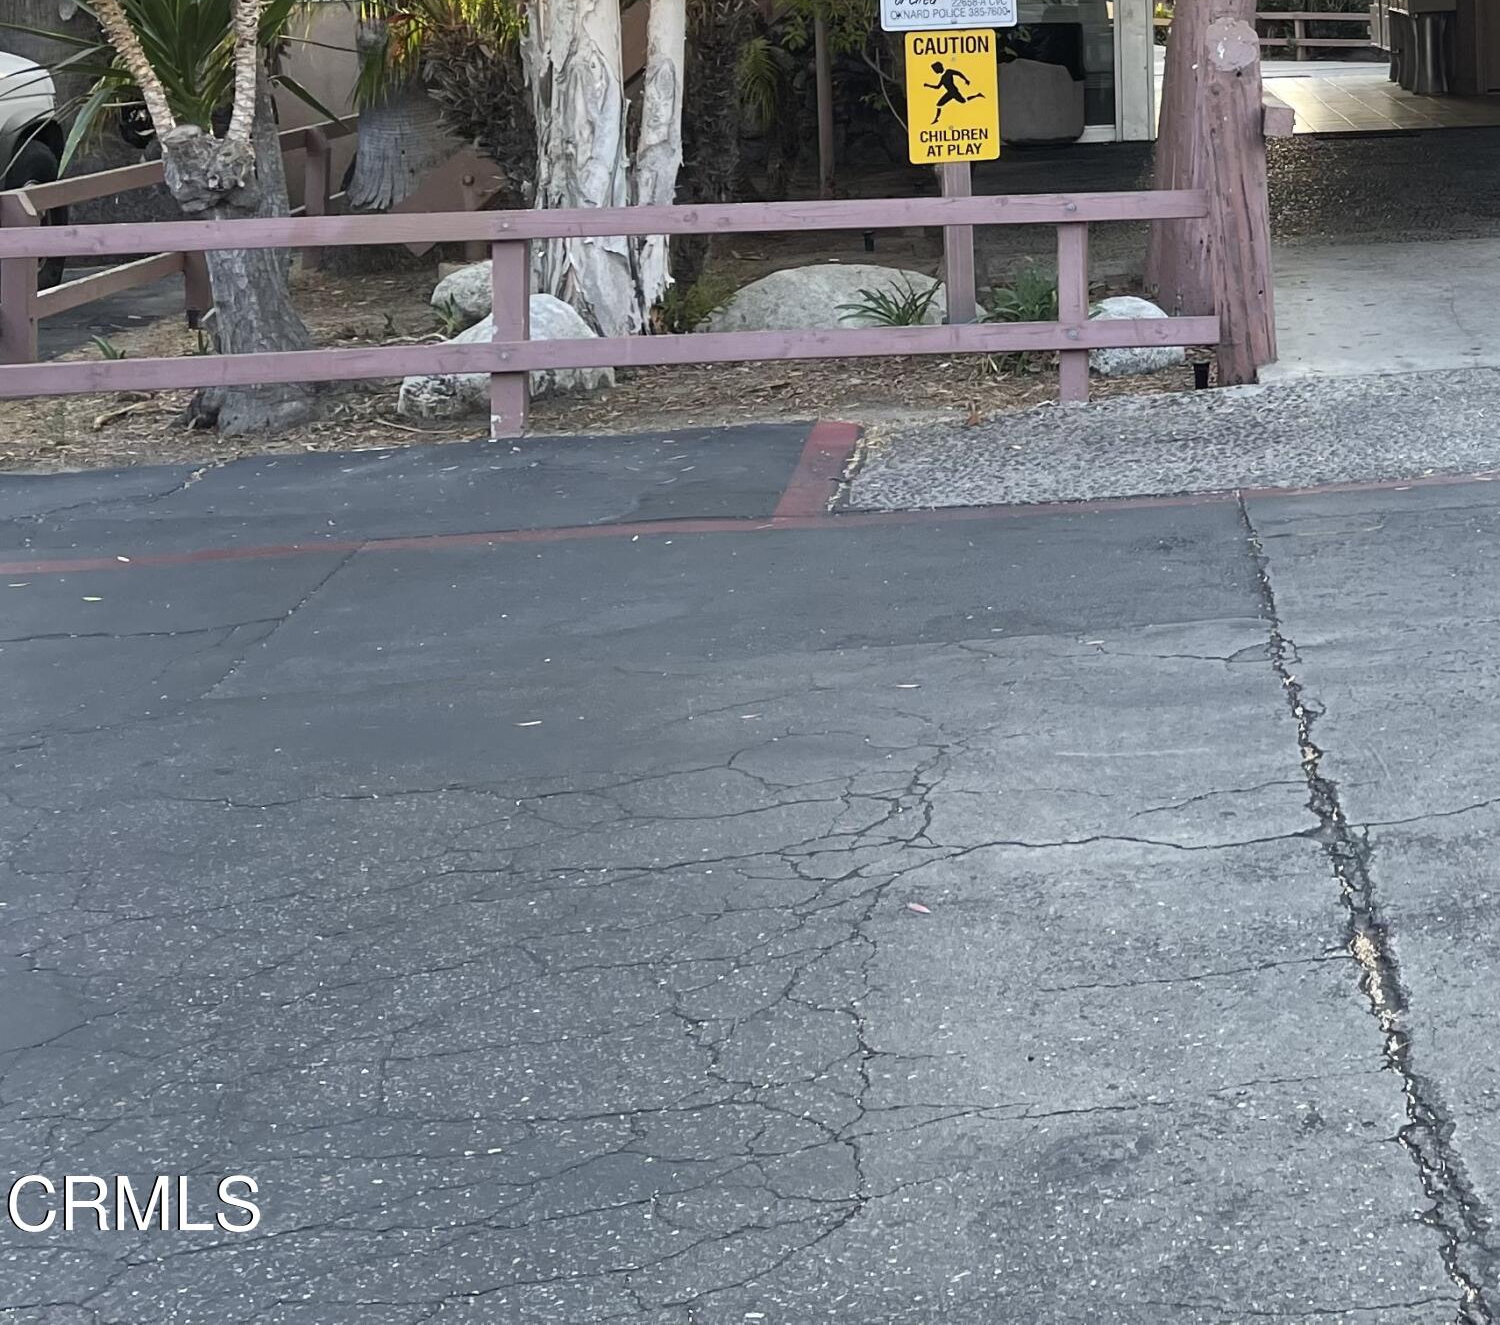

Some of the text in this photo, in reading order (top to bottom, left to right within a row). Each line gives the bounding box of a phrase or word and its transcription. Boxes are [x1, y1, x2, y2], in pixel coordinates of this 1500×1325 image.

[890, 9, 930, 20] OXNARD
[932, 8, 967, 19] POLICE
[913, 35, 989, 55] CAUTION
[920, 128, 989, 143] CHILDREN
[926, 143, 982, 157] AT PLAY
